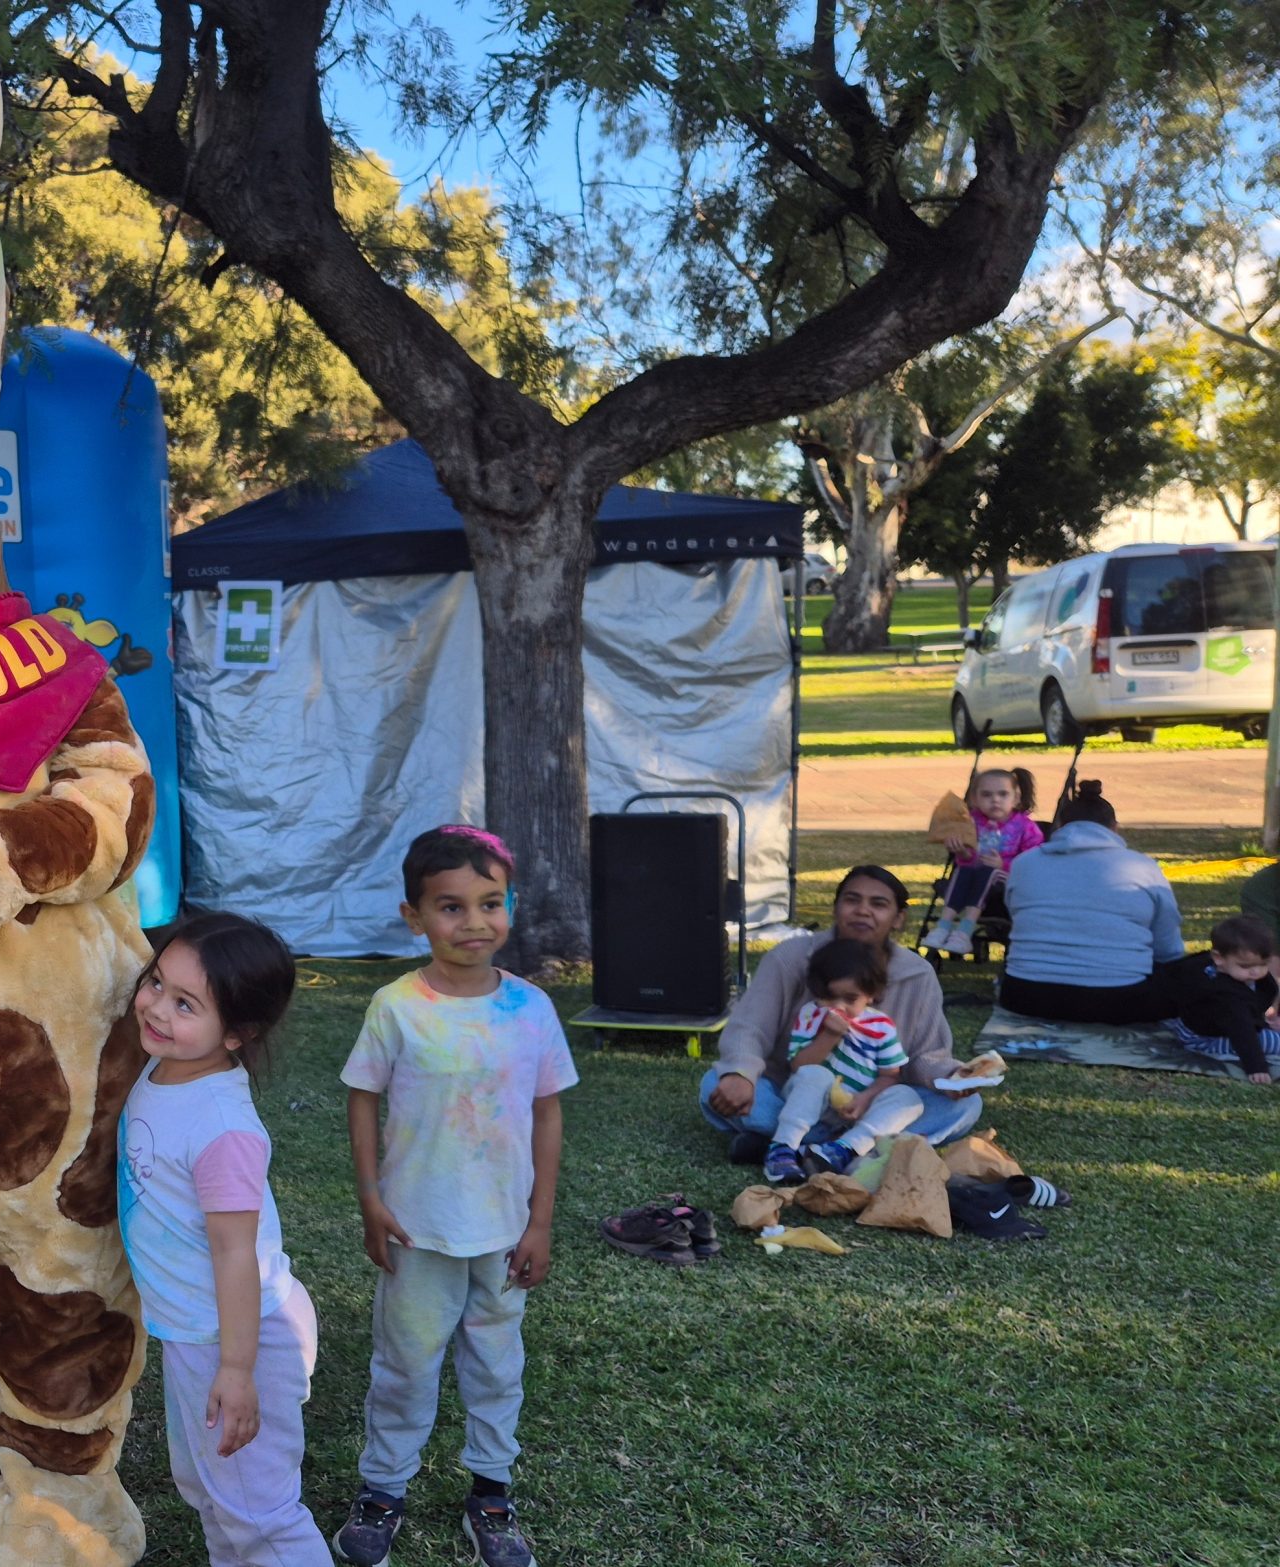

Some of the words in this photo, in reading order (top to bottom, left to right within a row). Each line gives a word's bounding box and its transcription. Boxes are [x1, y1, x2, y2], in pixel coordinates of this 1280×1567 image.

[188, 566, 231, 577] CLASSIC
[226, 644, 251, 652] FIRST
[252, 644, 269, 652] AID
